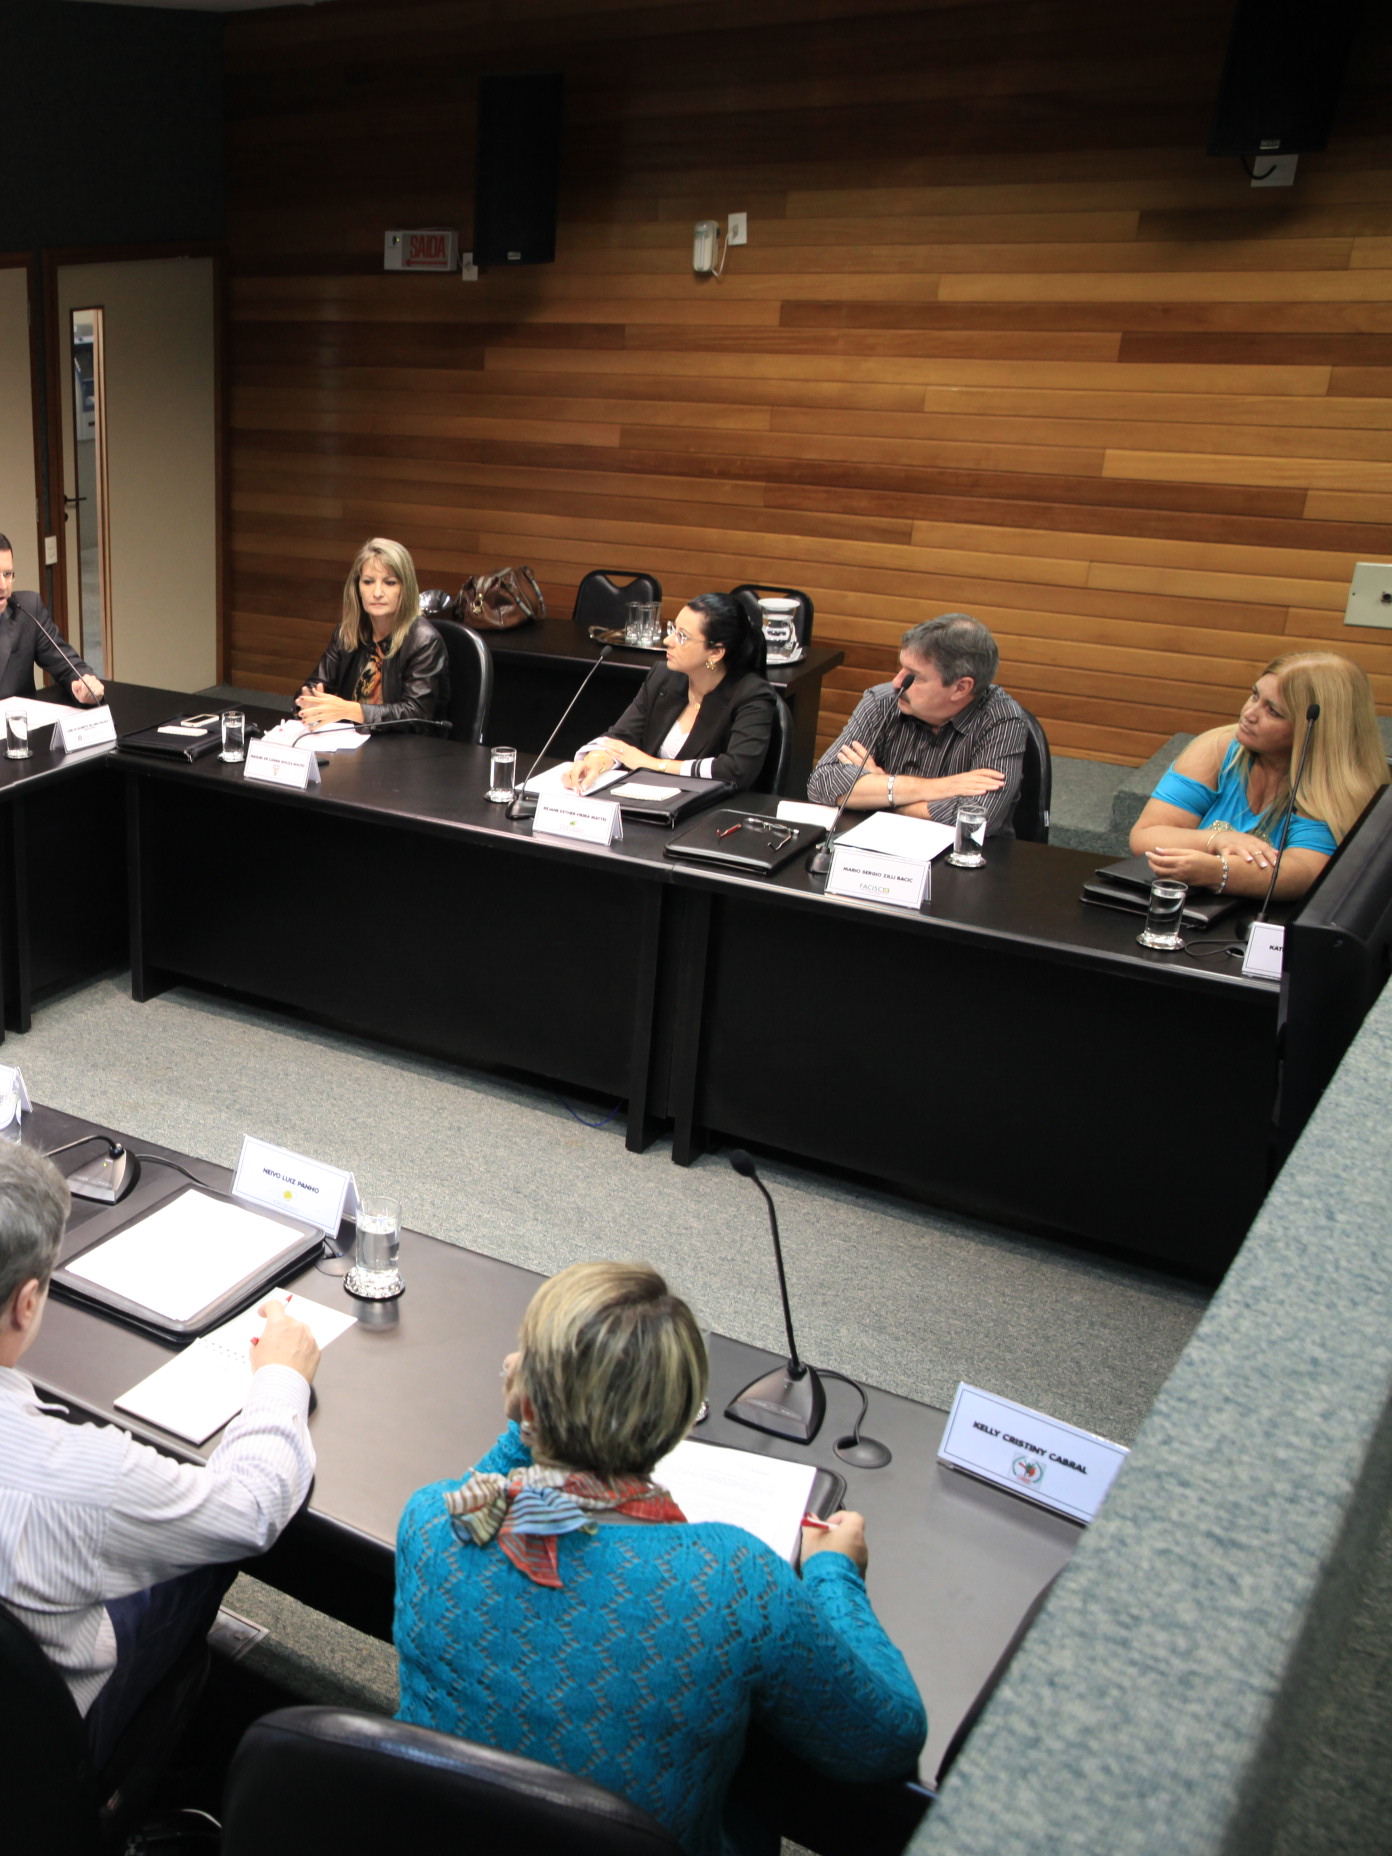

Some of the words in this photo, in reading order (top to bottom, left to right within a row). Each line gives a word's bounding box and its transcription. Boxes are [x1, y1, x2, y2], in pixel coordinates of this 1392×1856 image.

[262, 1168, 281, 1180] NEIVO
[282, 1175, 296, 1186] LUIZ
[296, 1180, 320, 1194] PANHO
[972, 1420, 1001, 1438] KELLY
[1002, 1433, 1048, 1457] CRISTINY
[1048, 1452, 1088, 1475] CABRAL
